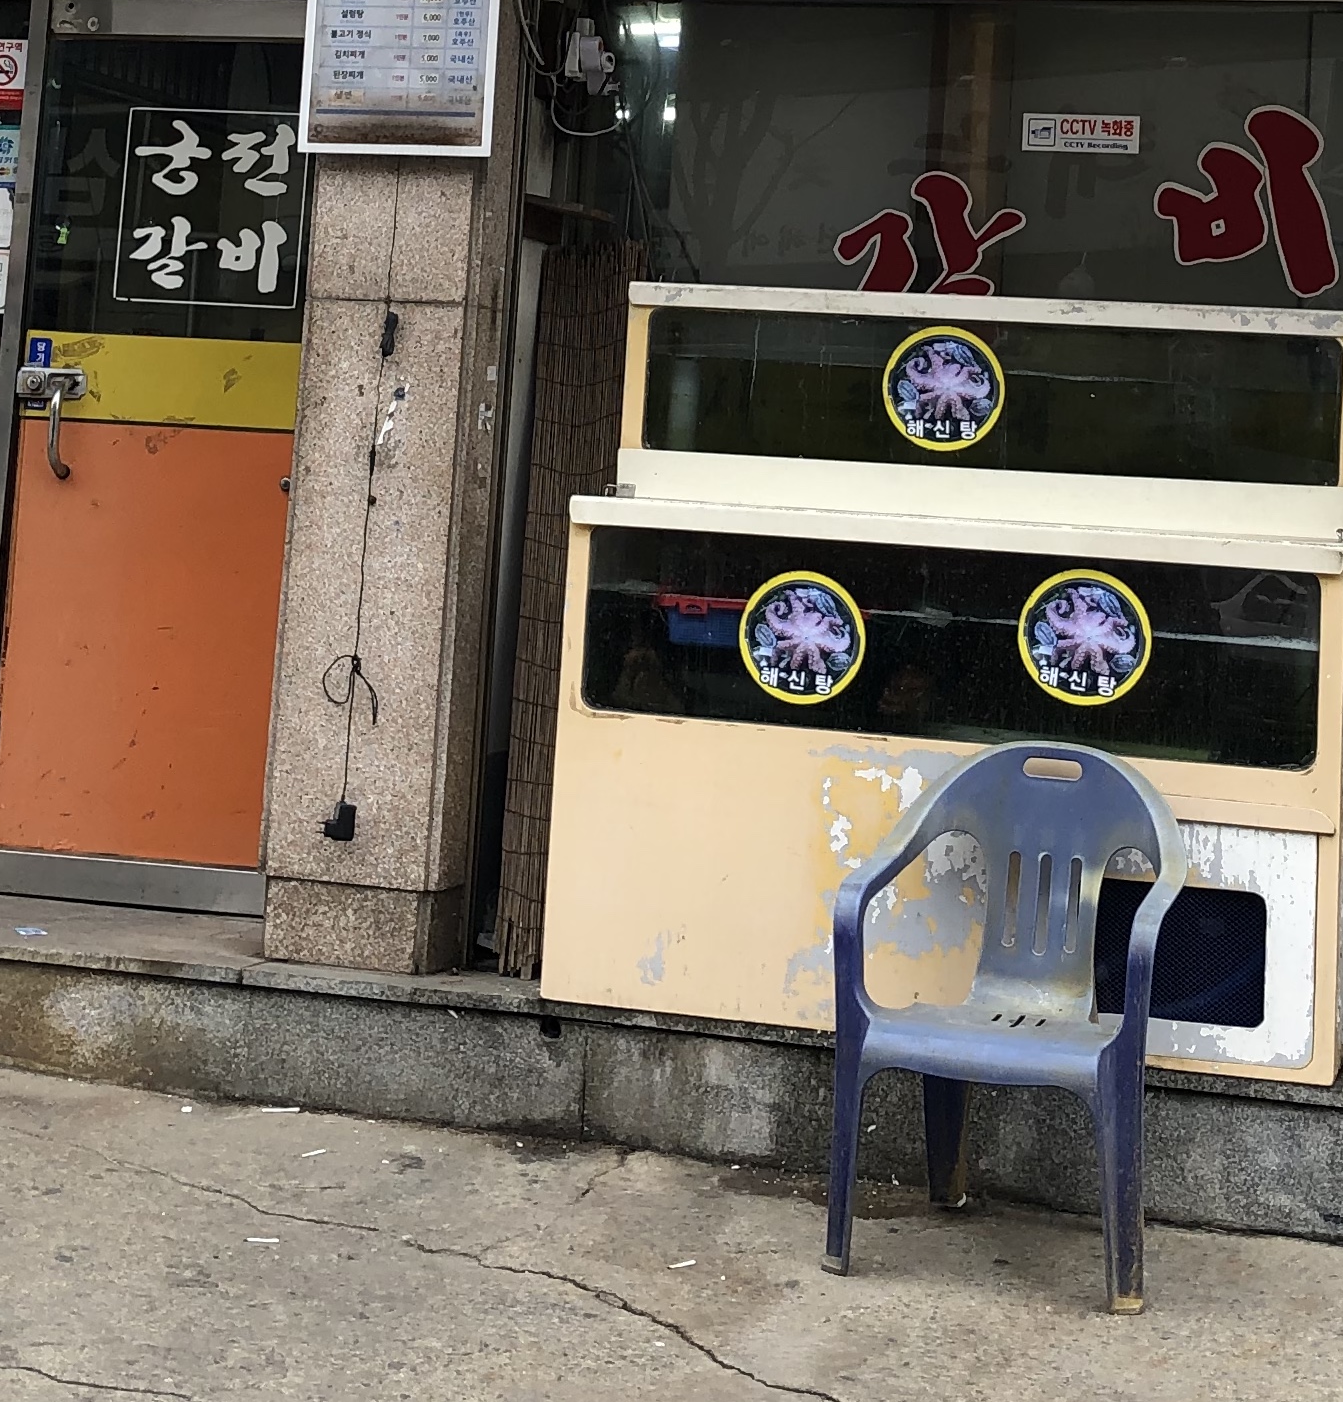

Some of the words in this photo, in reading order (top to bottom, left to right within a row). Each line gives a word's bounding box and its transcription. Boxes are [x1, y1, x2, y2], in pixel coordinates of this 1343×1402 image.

[331, 29, 353, 39] 불고기
[450, 54, 474, 64] 국내산
[448, 74, 473, 85] 국내산
[1060, 119, 1097, 136] CCTV
[1100, 119, 1134, 137] 녹화중
[134, 119, 296, 196] 궁전
[129, 215, 288, 294] 갈비
[905, 418, 978, 441] 해신탕
[759, 666, 834, 696] 해신탕
[1038, 665, 1118, 697] 해신탕
